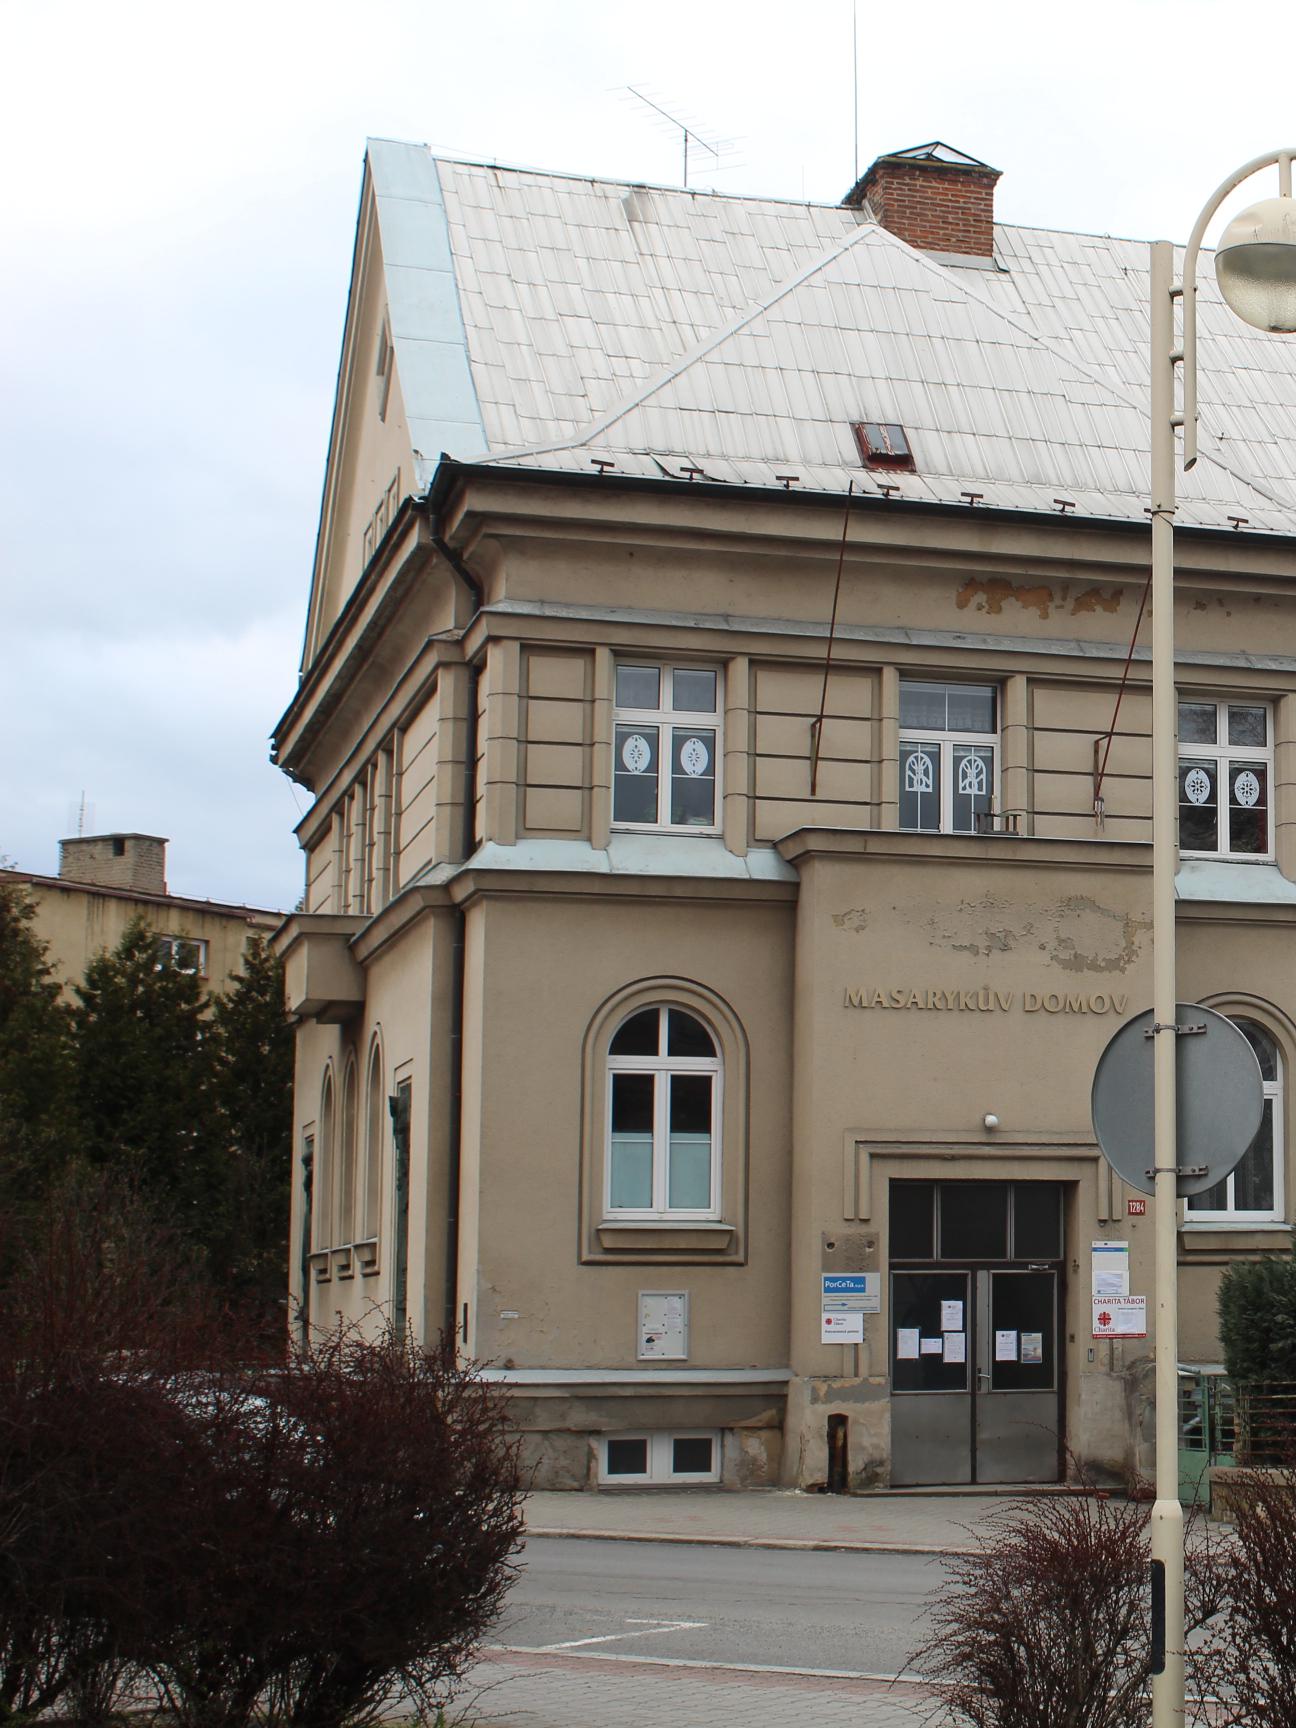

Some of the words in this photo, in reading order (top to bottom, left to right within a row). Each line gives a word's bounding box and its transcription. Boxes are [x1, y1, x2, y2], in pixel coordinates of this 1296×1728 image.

[843, 985, 1015, 1011] MASARYKŮV
[1023, 991, 1129, 1015] DOMOV
[1129, 1202, 1144, 1213] 1284
[825, 1280, 854, 1288] PorCeTa
[1123, 1297, 1145, 1305] TÁBOR
